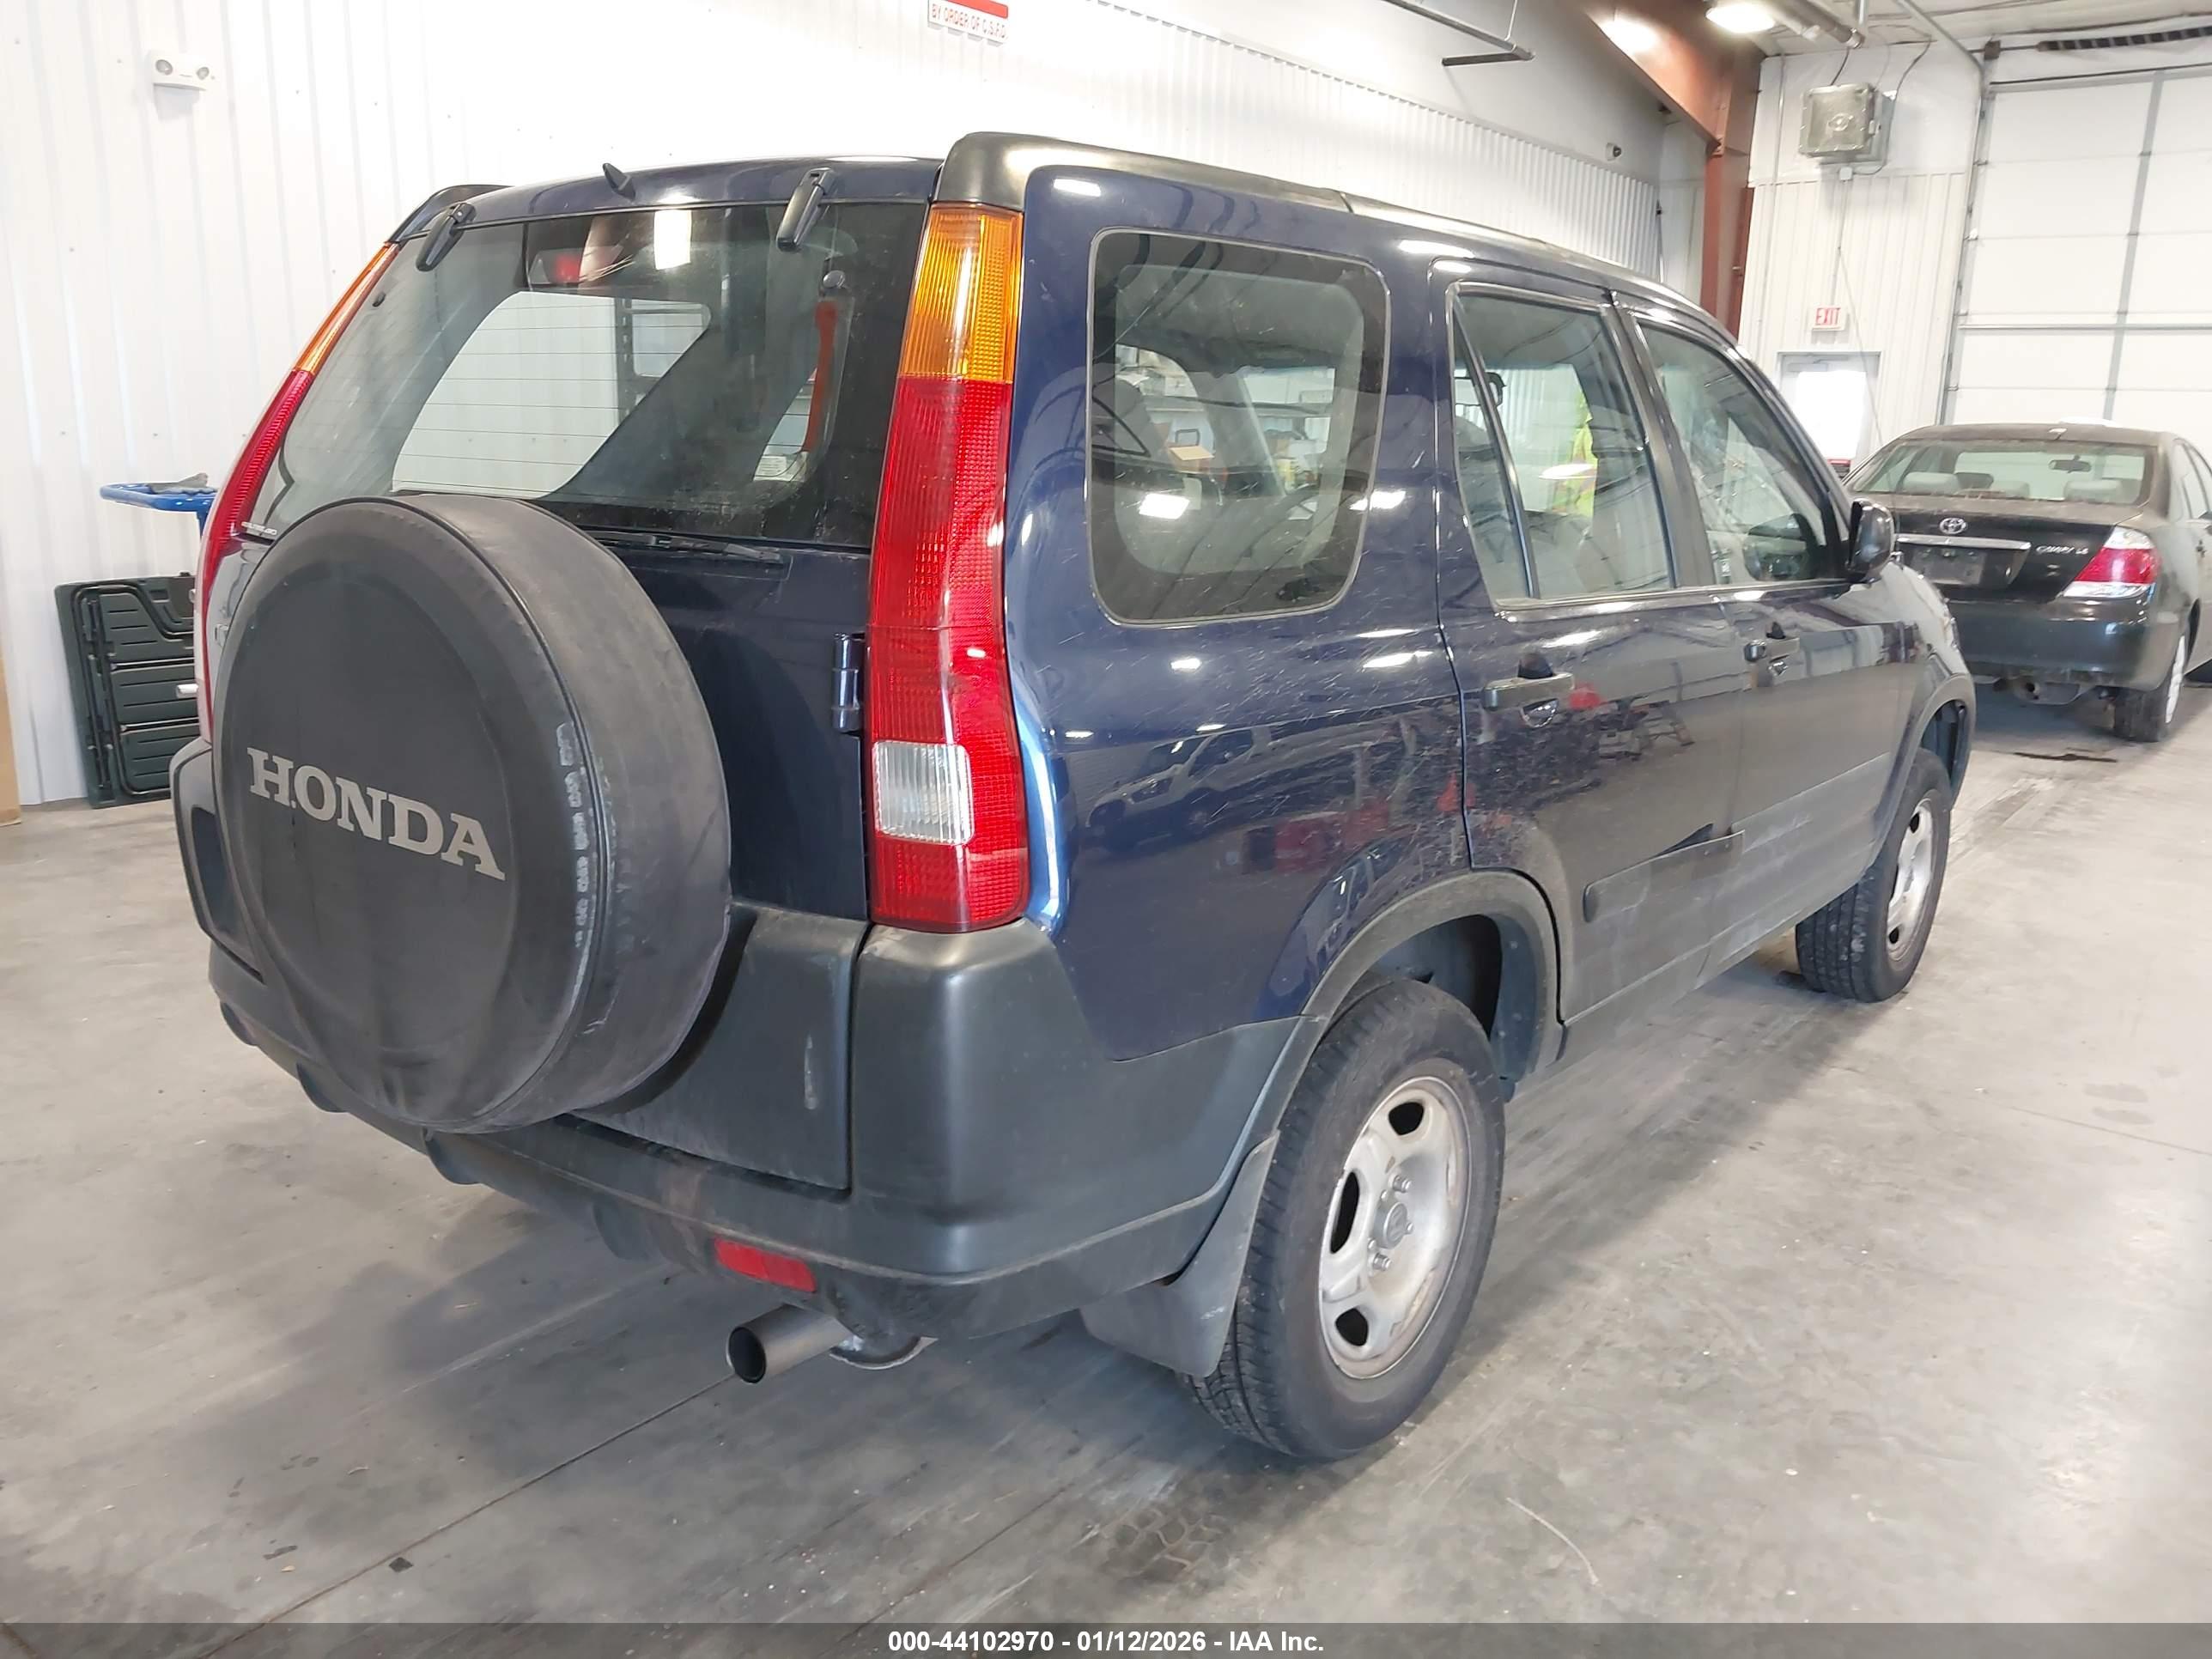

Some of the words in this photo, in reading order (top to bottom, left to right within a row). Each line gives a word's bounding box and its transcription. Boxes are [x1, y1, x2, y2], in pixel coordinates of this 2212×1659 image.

[932, 3, 942, 21] BY
[945, 6, 969, 28] ORDER
[971, 15, 981, 32] OF
[1815, 307, 1841, 325] EXIT
[247, 747, 506, 881] HONDA
